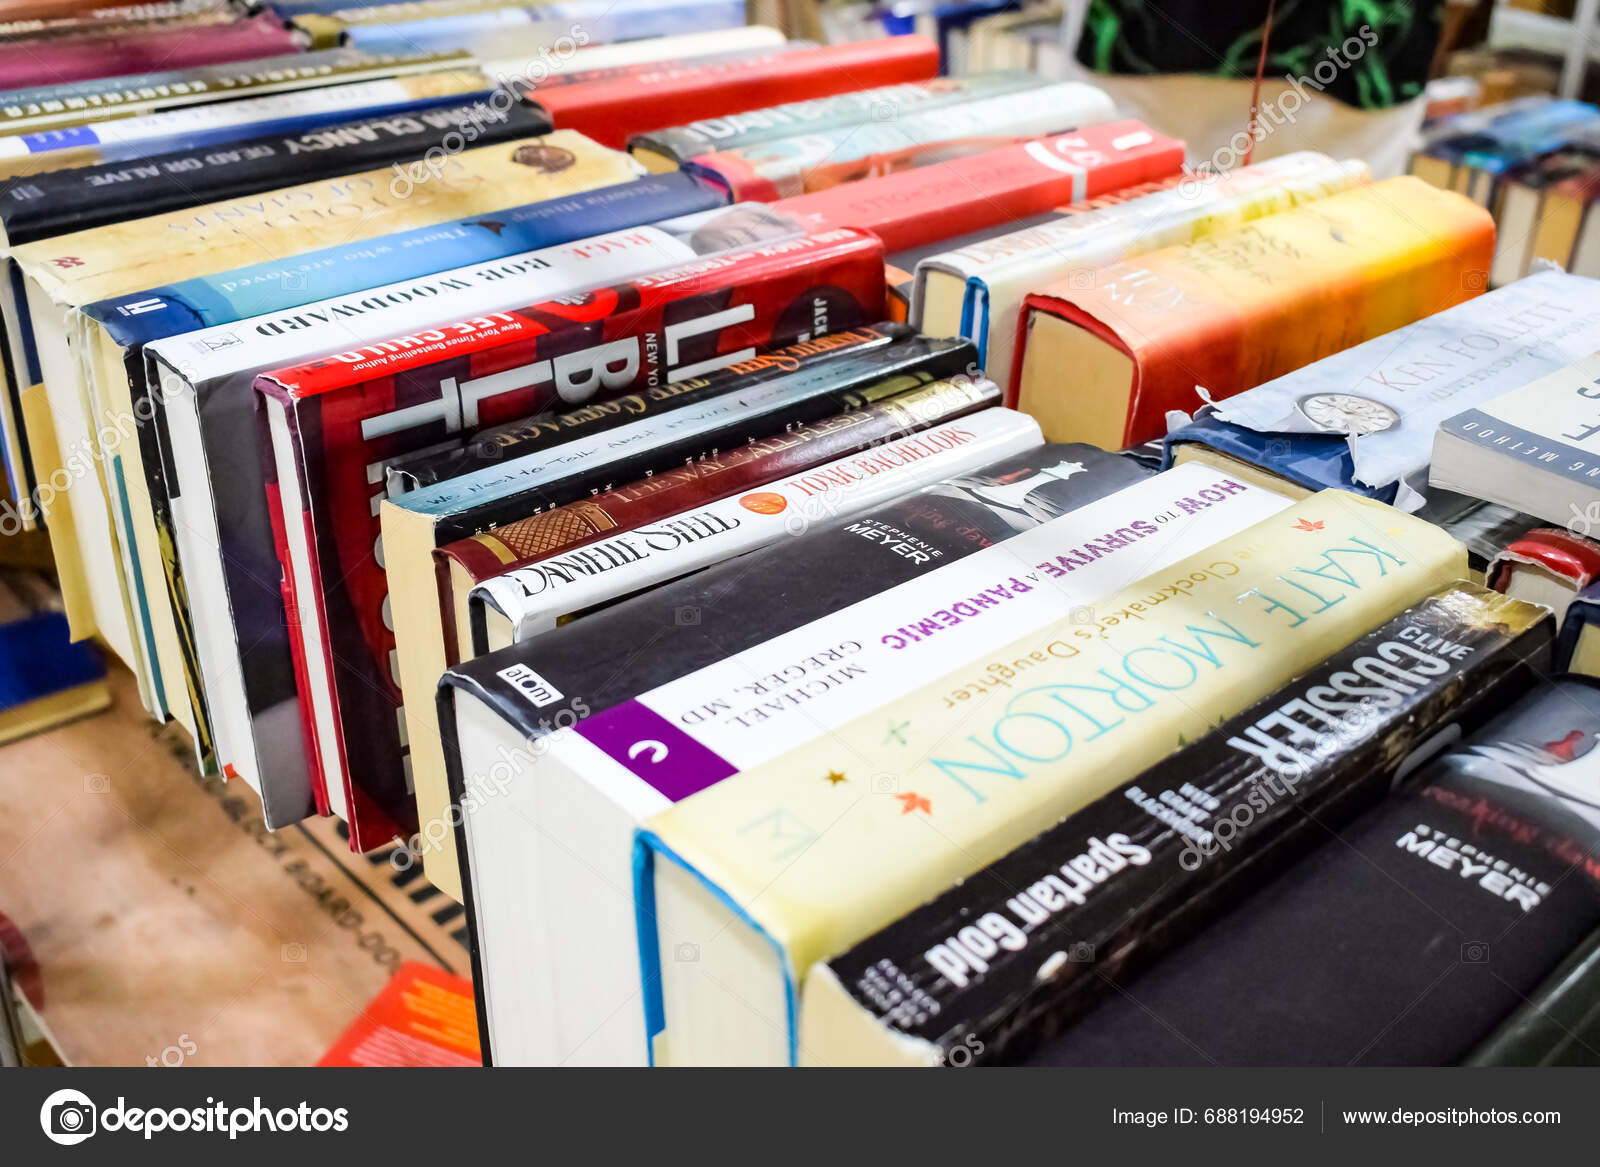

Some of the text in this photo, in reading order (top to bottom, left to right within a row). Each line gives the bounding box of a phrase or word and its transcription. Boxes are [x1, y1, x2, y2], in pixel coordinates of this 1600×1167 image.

[84, 164, 161, 188] ALIVE
[164, 157, 204, 174] OR
[343, 245, 393, 262] who
[563, 230, 654, 262] RAGE
[255, 257, 553, 337] BOB WOODWARD
[812, 297, 829, 336] JACK
[331, 310, 515, 365] LEE CHILD
[352, 321, 523, 373] New York Times Bestselling Author
[645, 332, 658, 356] NEW
[748, 436, 797, 461] ALL
[799, 407, 876, 443] FLESH
[1463, 421, 1560, 463] METHOD
[520, 466, 542, 478] to
[784, 424, 978, 498] TOXIC BACHELORS
[513, 510, 741, 597] DANIELLE STEEL
[843, 521, 933, 567] MEYER
[860, 518, 945, 559] STEPHENIE
[879, 478, 1250, 651] HOW TO SURVIVE A PANDEMIC
[1073, 561, 1241, 641] Clockmaker's
[929, 536, 1407, 804] KATE MORTON
[1399, 625, 1476, 662] CLIVE
[723, 662, 868, 729] MICHAEL
[942, 640, 1082, 709] Daughter
[680, 697, 733, 726] MD
[1226, 640, 1451, 777] CUSSLER
[1395, 831, 1541, 913] MEYER
[924, 831, 1152, 988] Spartan Gold
